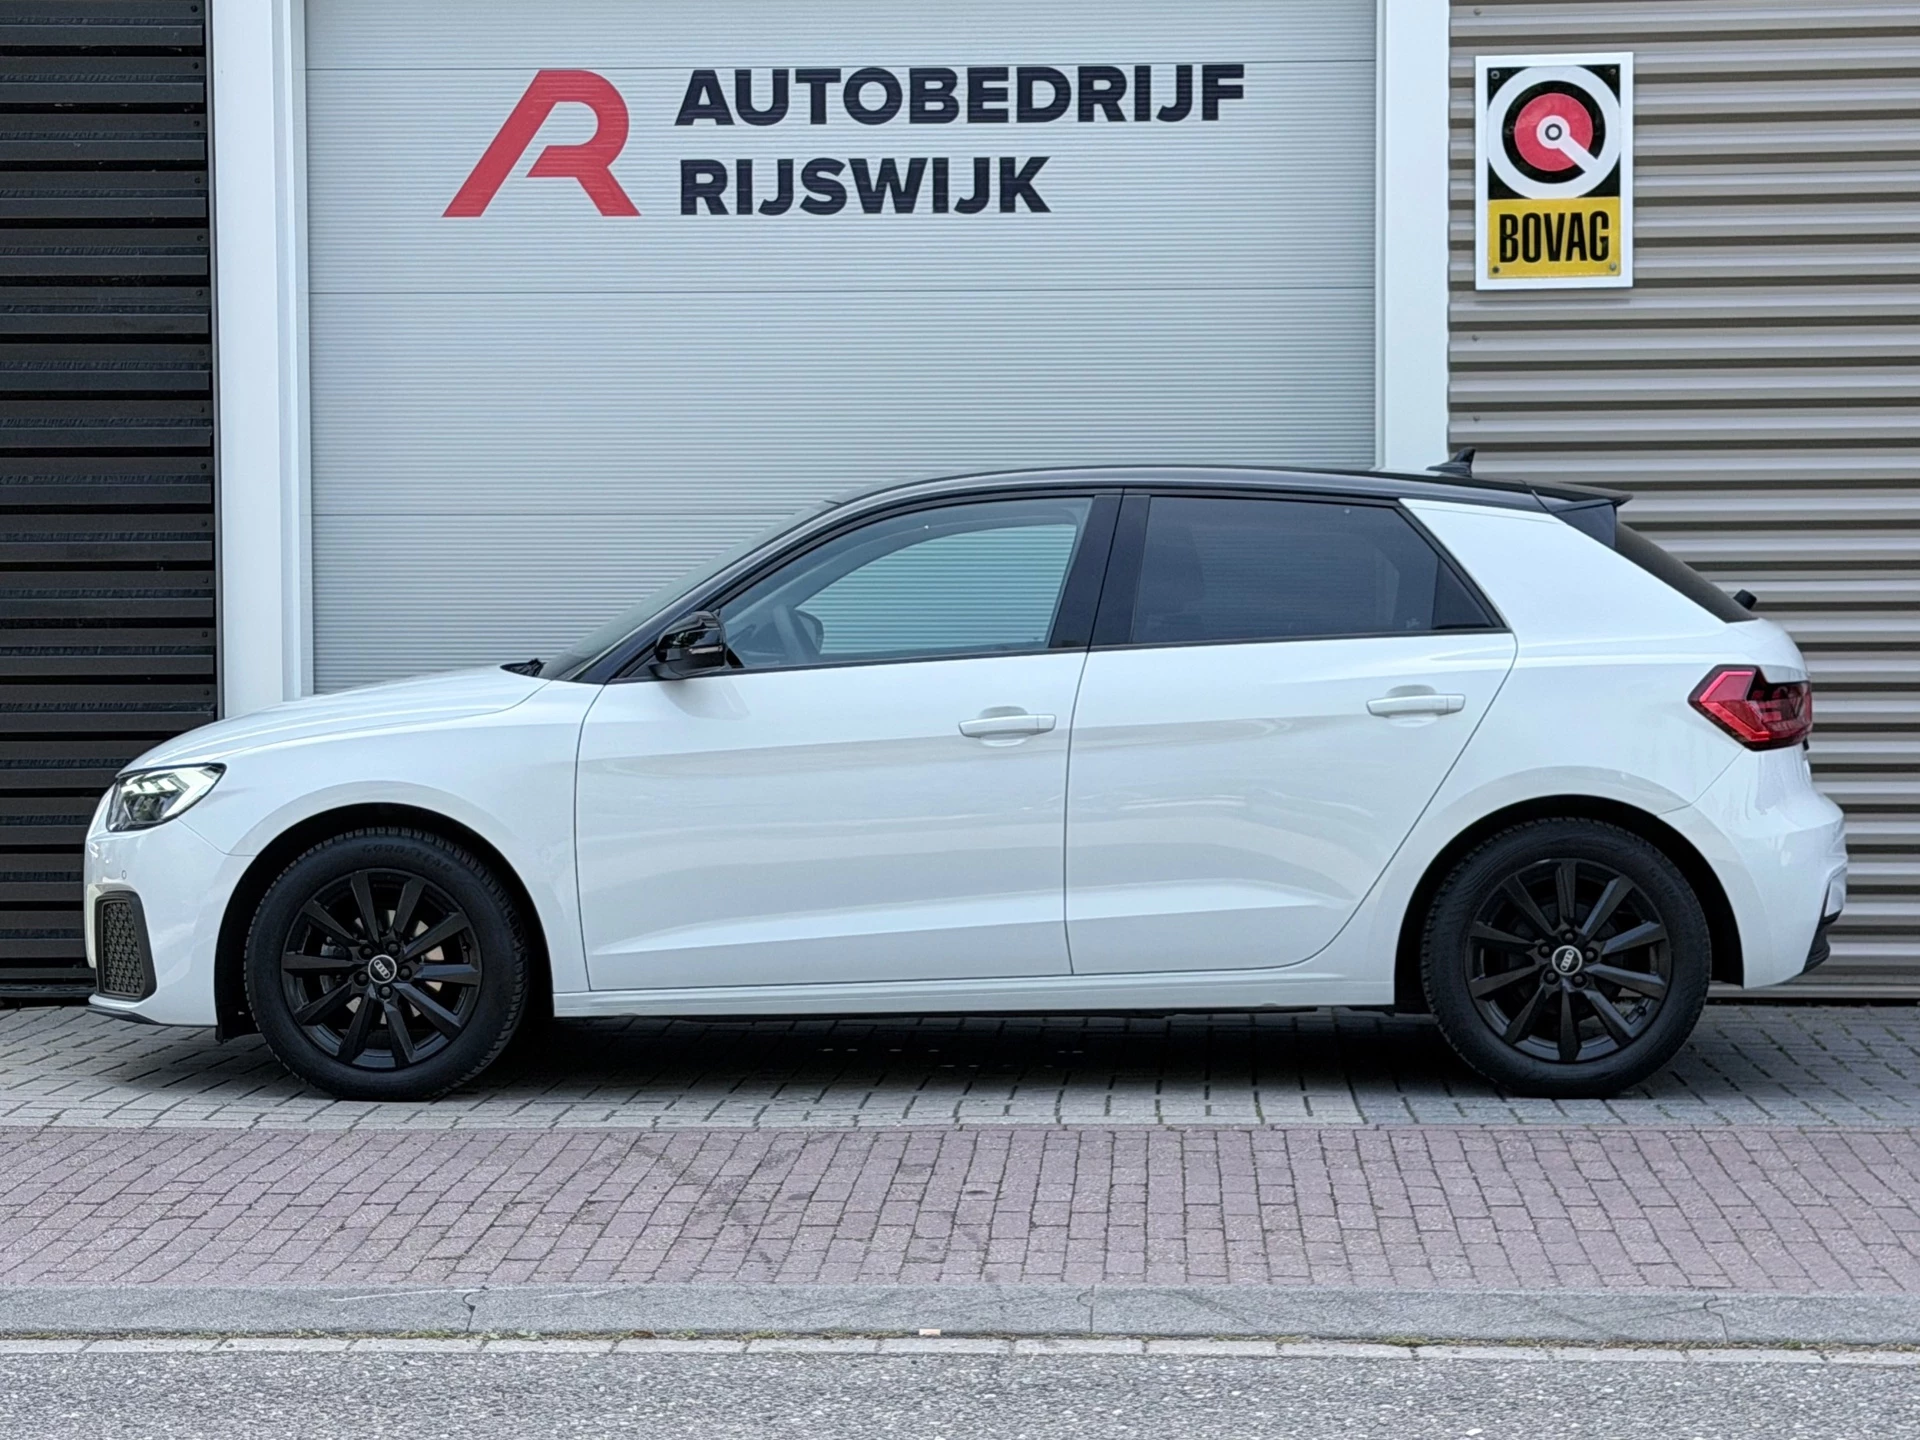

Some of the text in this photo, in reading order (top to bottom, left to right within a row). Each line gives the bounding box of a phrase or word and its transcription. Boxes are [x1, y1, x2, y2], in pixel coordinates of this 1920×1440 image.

[674, 64, 1245, 126] AUTOBEDRIJF
[679, 157, 1052, 216] RIJSWIJK
[1499, 211, 1609, 263] BOVAG
